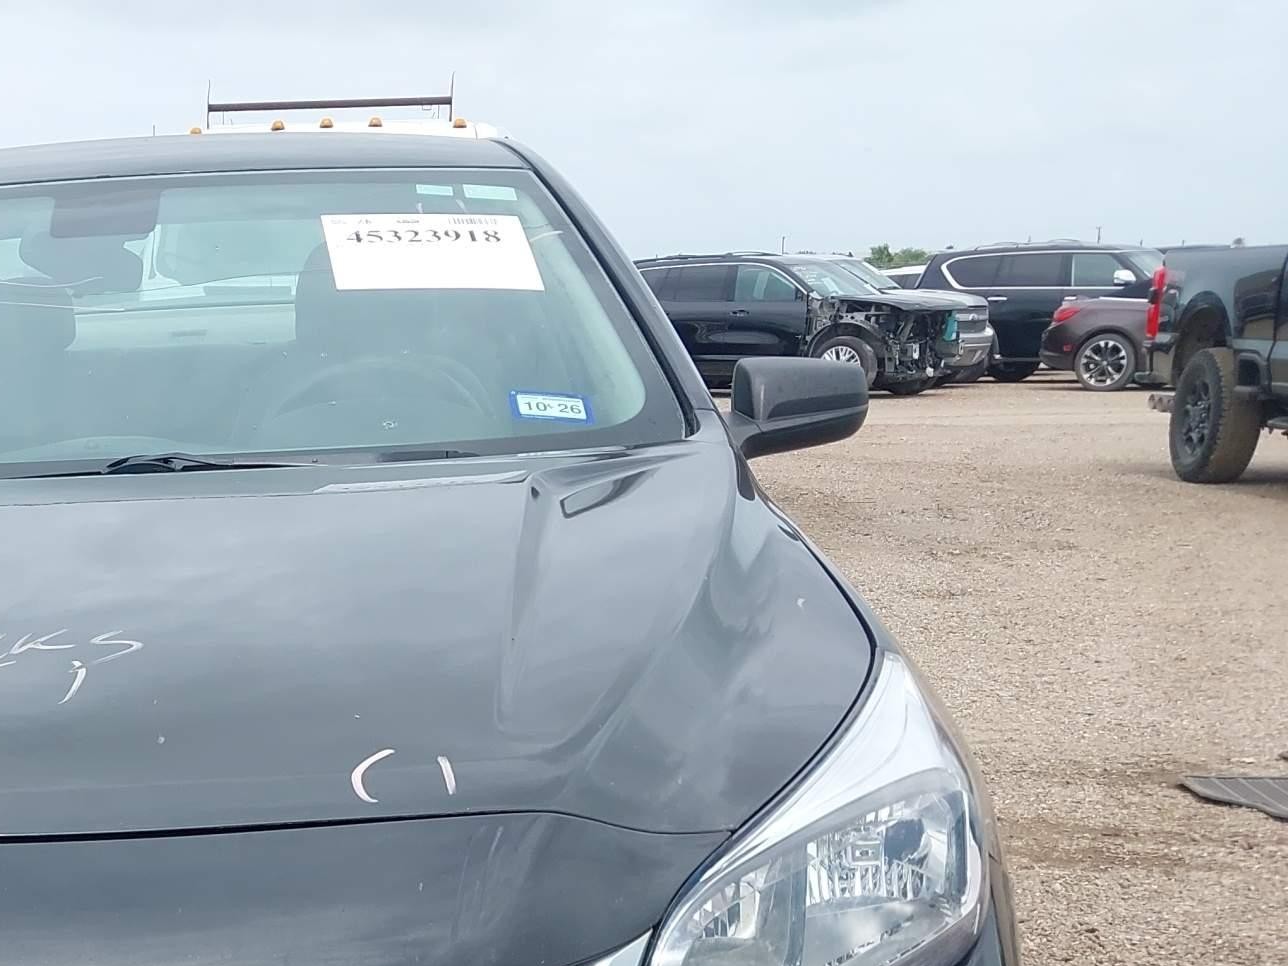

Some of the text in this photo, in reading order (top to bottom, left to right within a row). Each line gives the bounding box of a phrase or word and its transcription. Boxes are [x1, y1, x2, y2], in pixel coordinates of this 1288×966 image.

[346, 229, 501, 243] 45323918
[523, 401, 582, 415] 10 26
